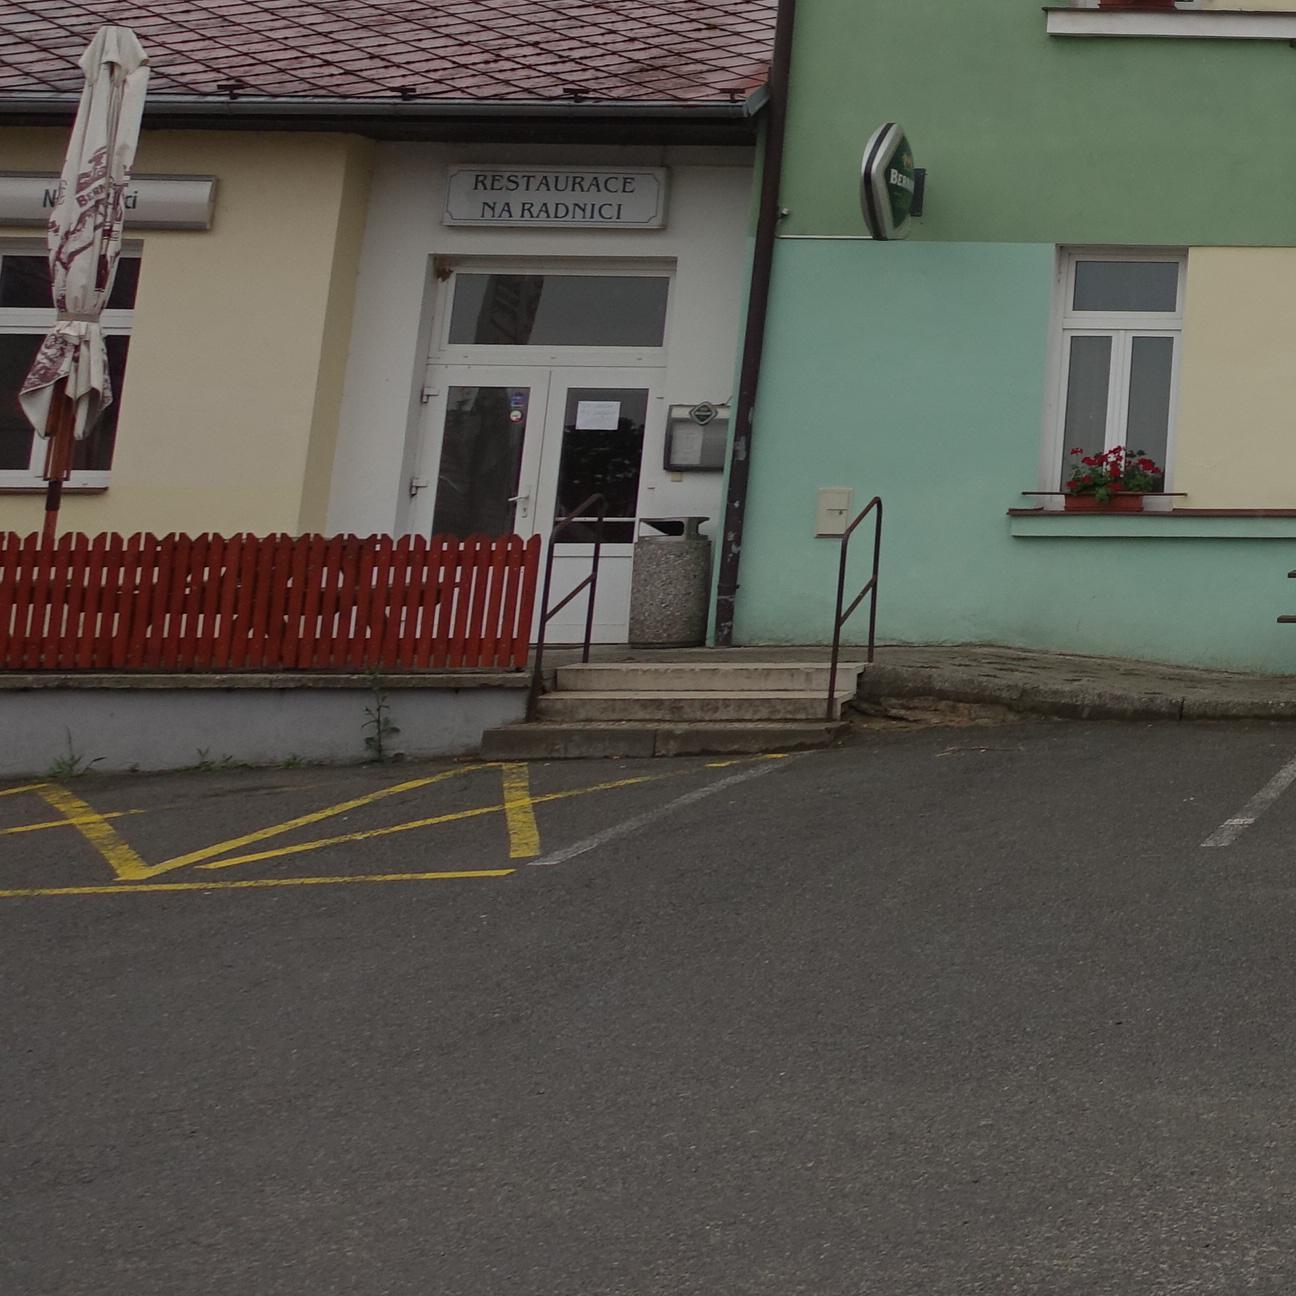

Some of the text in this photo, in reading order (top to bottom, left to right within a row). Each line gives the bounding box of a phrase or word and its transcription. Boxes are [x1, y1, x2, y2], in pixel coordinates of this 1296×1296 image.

[473, 174, 636, 193] RESTAURACE
[480, 201, 623, 220] NA RADNICI
